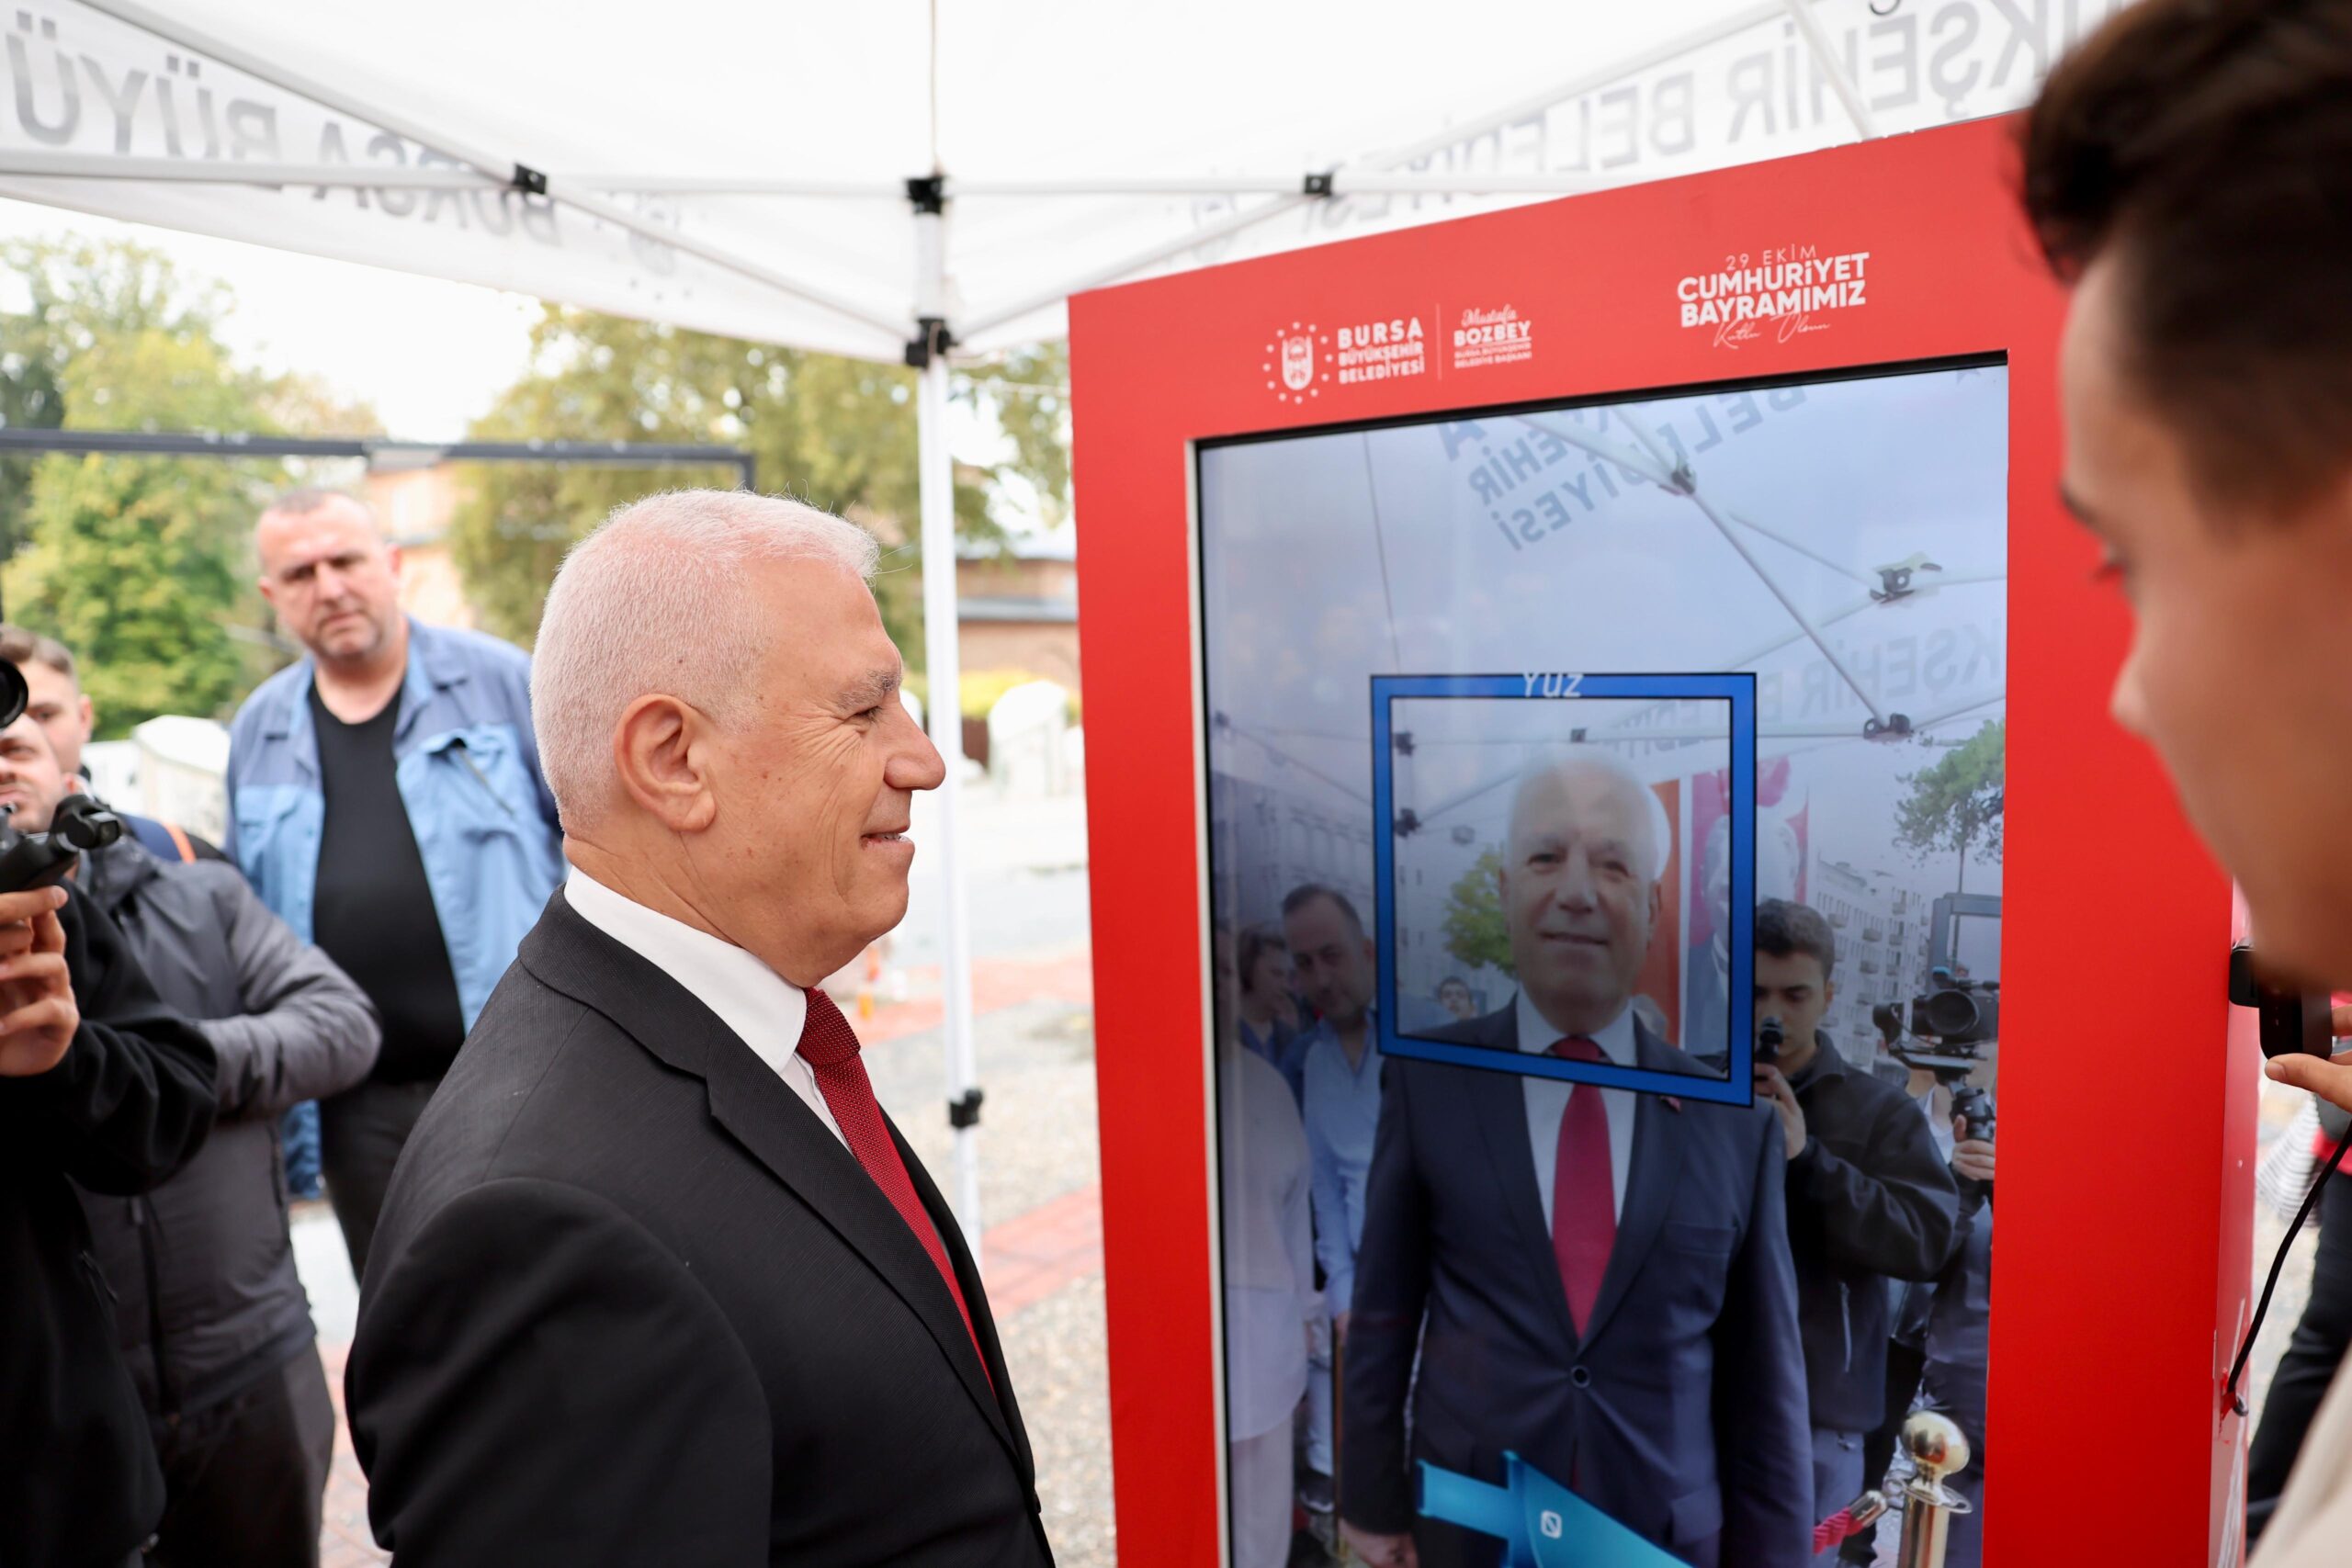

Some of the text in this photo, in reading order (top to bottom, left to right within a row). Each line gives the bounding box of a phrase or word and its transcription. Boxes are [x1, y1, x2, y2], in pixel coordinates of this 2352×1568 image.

[1725, 243, 1817, 271] 29 EKİM
[1461, 304, 1517, 328] Mustafa
[1680, 279, 1866, 328] BAYRAMIMIZ
[1338, 317, 1423, 349] BURSA
[1453, 320, 1532, 347] BOZBEY
[1713, 312, 1830, 349] Kutlu Olsun
[1339, 357, 1425, 384] BELEDİYESİ
